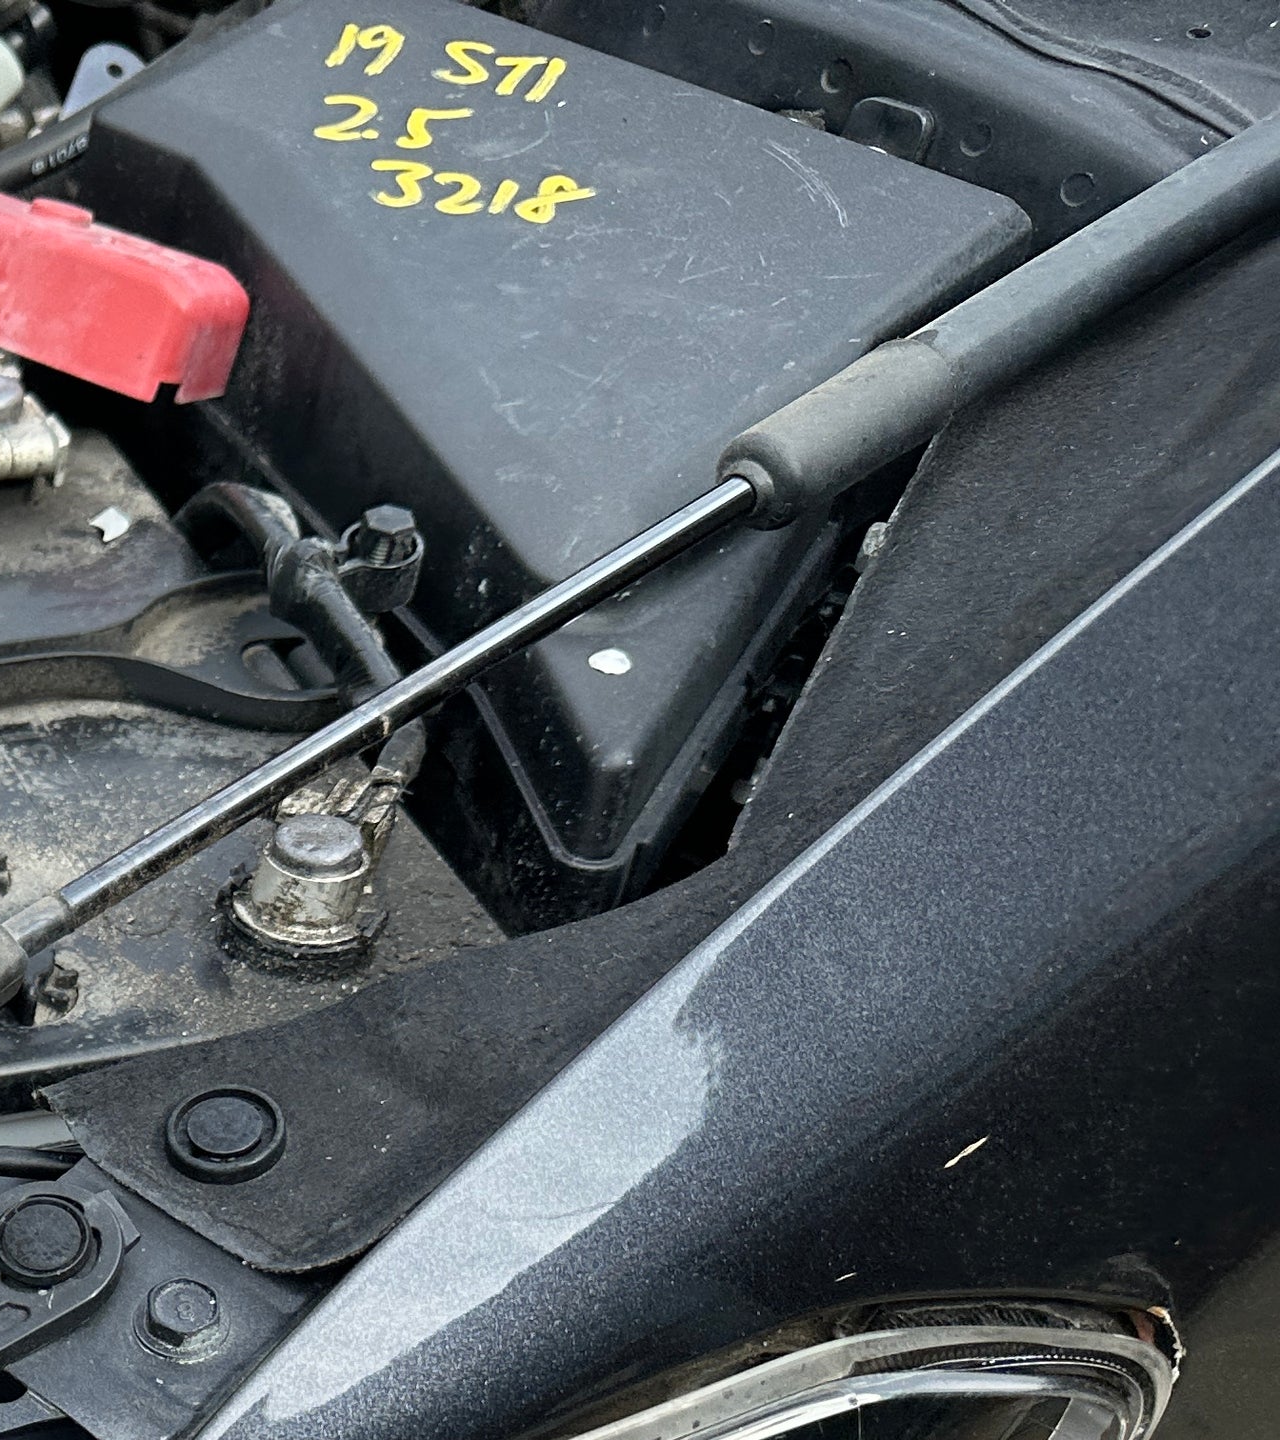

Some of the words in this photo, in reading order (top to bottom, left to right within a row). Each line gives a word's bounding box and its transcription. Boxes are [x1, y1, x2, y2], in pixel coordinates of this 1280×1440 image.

[324, 23, 405, 76] 19
[313, 94, 474, 149] 2.5
[370, 159, 596, 223] 3218
